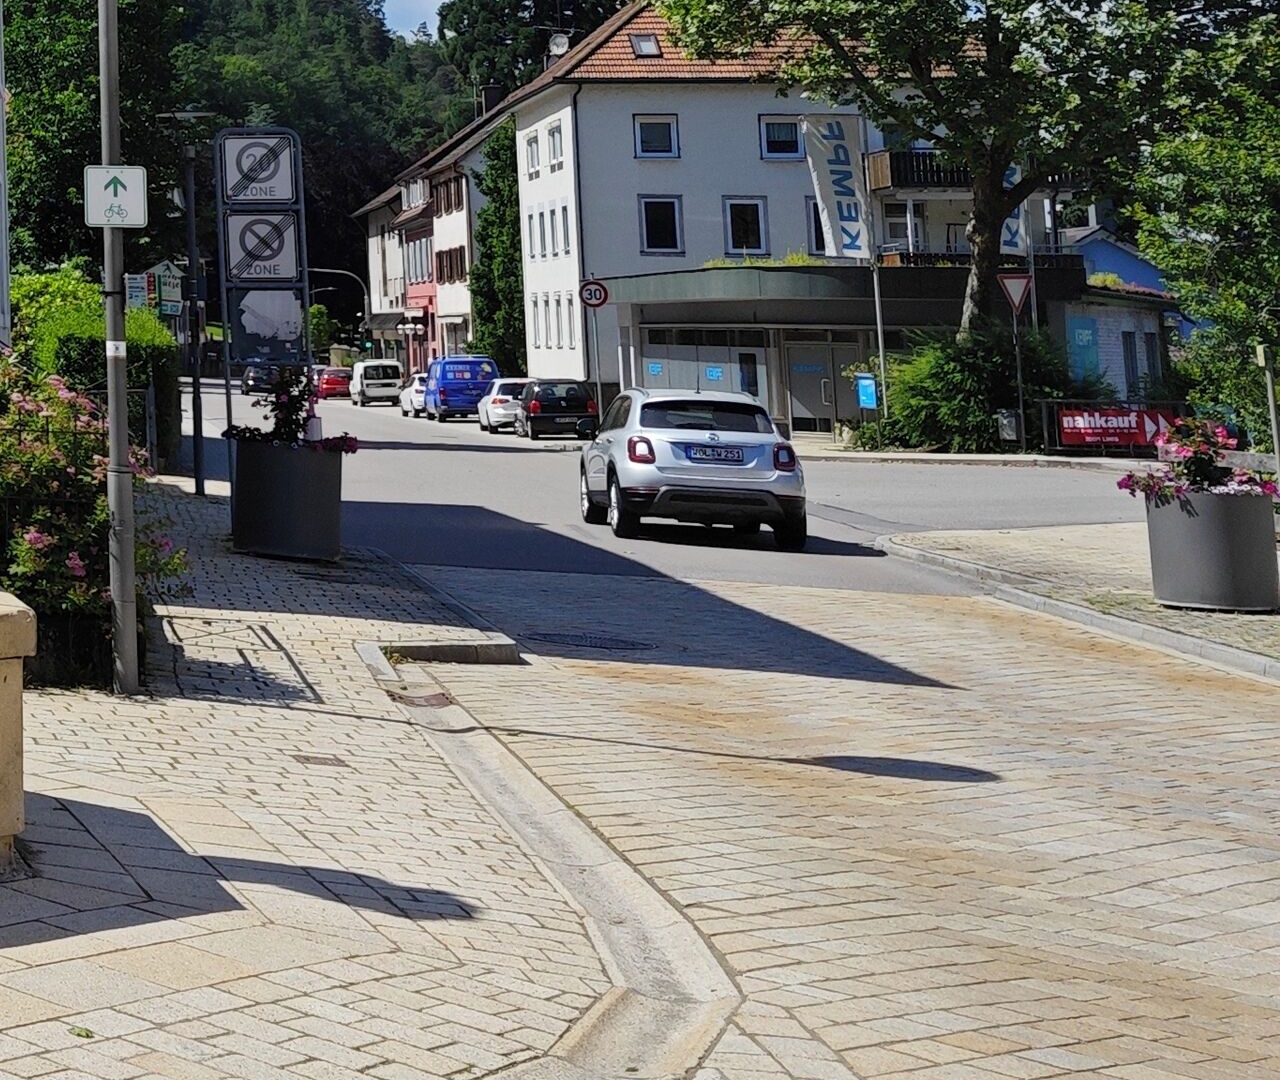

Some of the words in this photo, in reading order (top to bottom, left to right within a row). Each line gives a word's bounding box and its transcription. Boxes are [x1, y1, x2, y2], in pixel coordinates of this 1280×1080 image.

[246, 264, 281, 276] ZONE
[585, 288, 601, 301] 30
[1062, 412, 1138, 428] nahkauf
